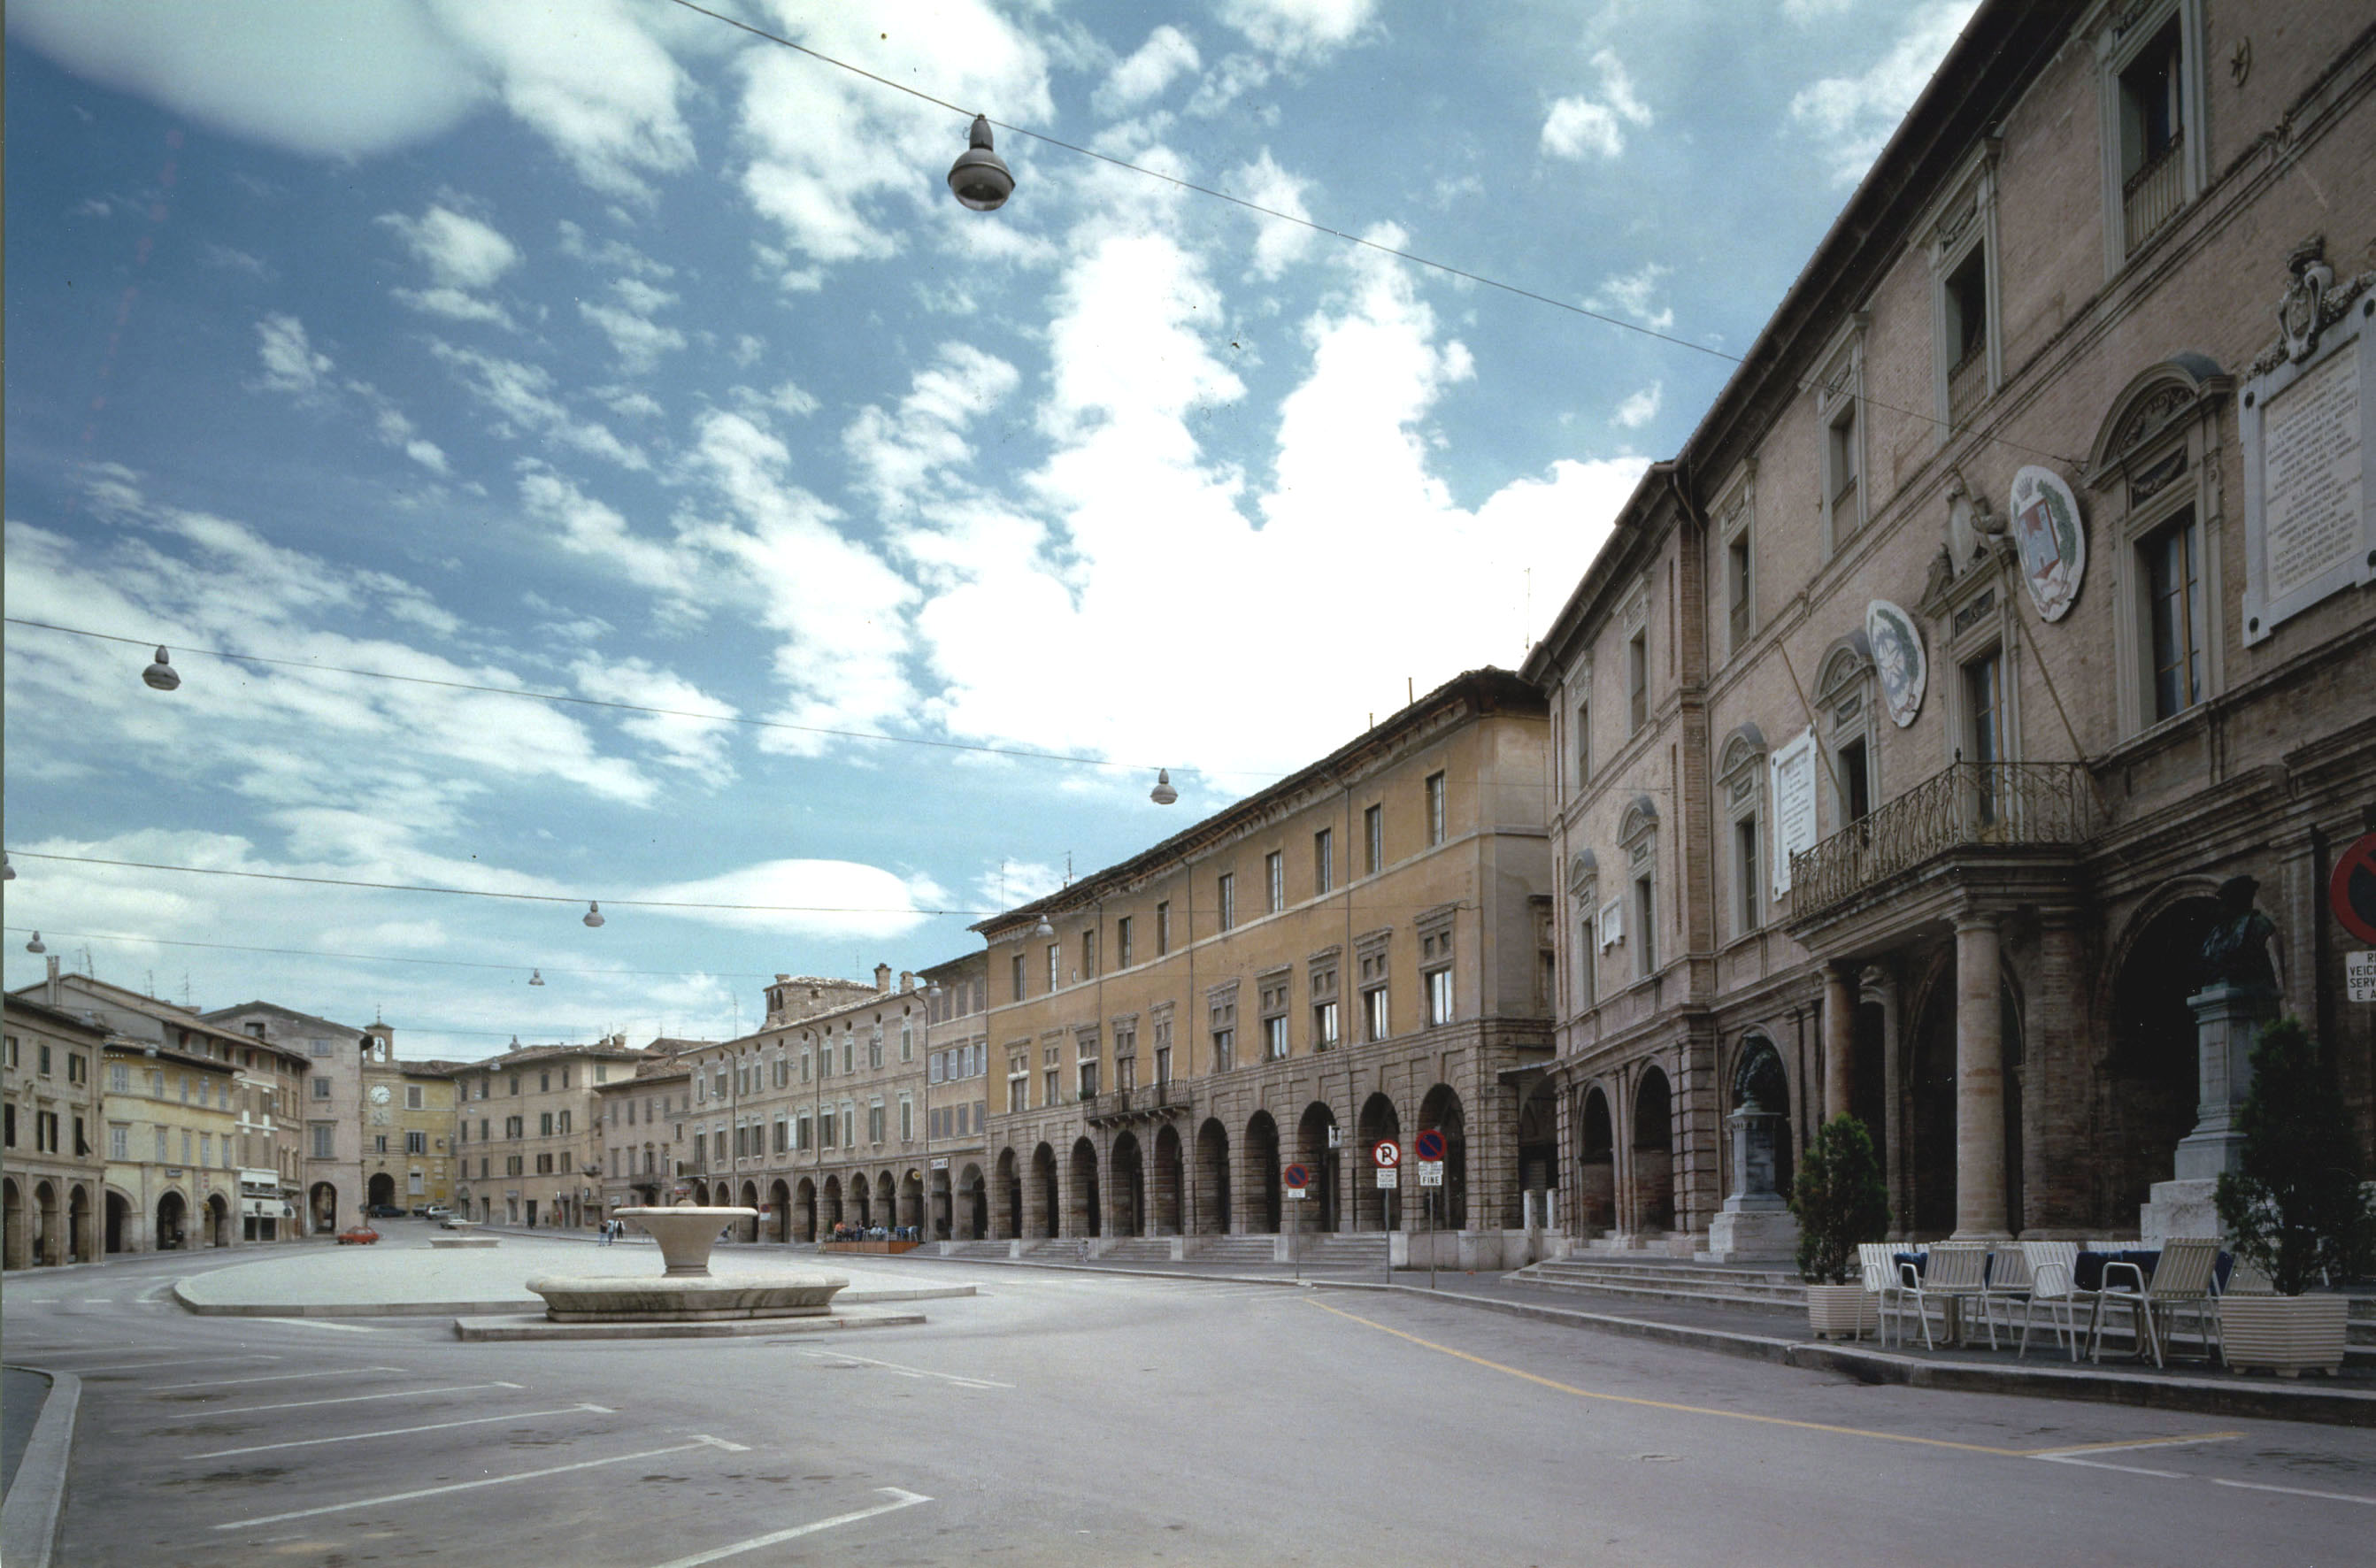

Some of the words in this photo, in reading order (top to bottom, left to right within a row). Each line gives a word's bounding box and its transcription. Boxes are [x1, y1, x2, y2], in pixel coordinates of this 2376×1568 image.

[2367, 952, 2376, 964] R
[2349, 965, 2376, 976] VEIC
[2357, 989, 2364, 1000] E
[1331, 1126, 1341, 1141] T
[1422, 1175, 1441, 1184] FINE
